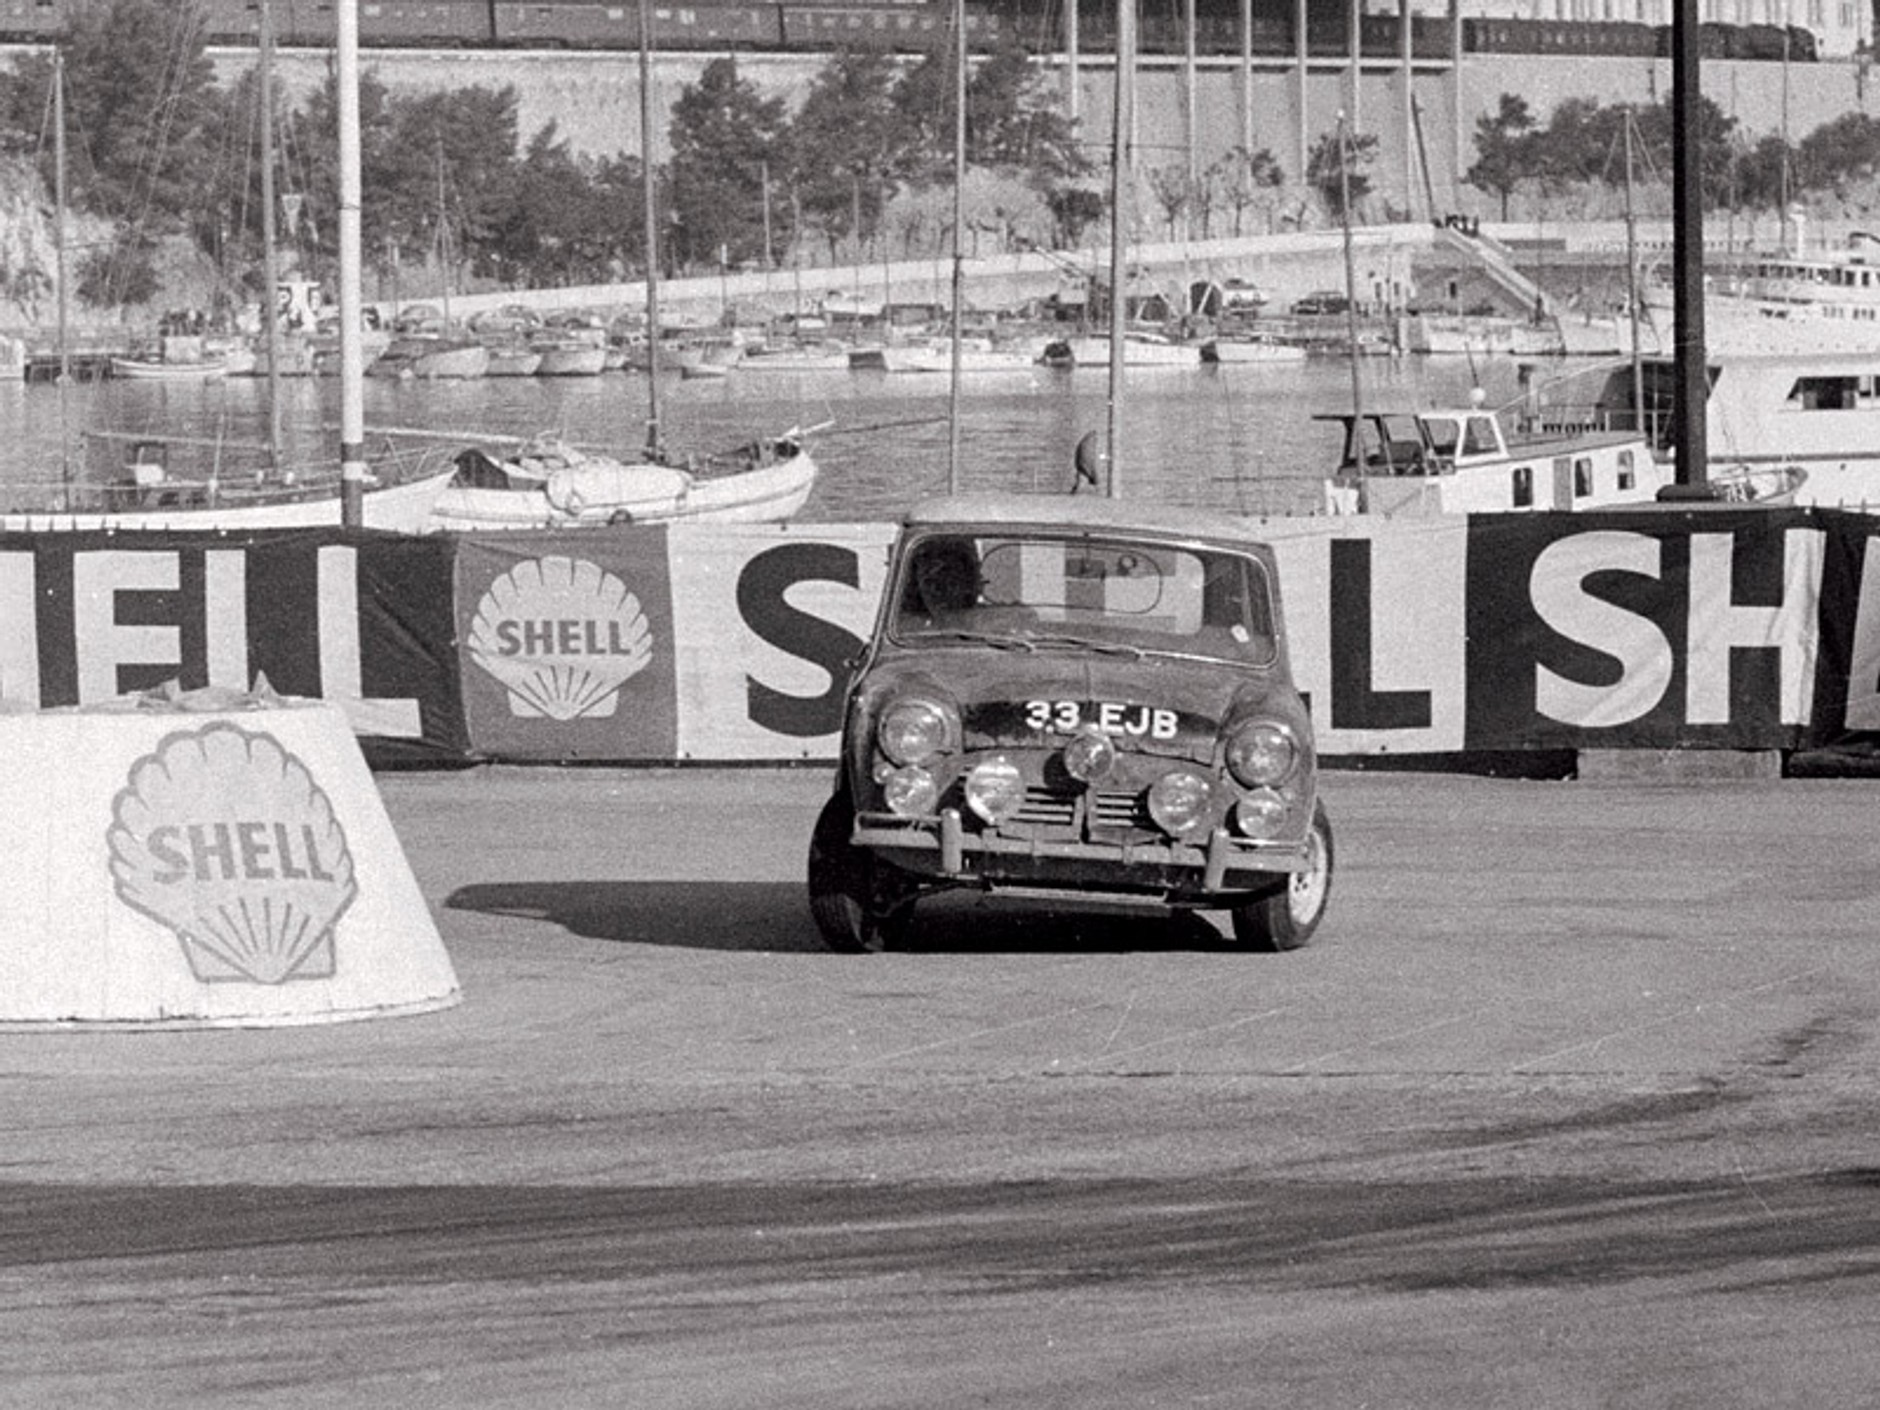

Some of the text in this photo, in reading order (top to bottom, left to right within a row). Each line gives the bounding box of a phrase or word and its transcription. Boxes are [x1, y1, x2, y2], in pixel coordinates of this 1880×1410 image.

[0, 546, 422, 737] ELL
[497, 620, 631, 656] SHELL
[1025, 700, 1178, 739] 33 EJB
[147, 822, 334, 885] SHELL
